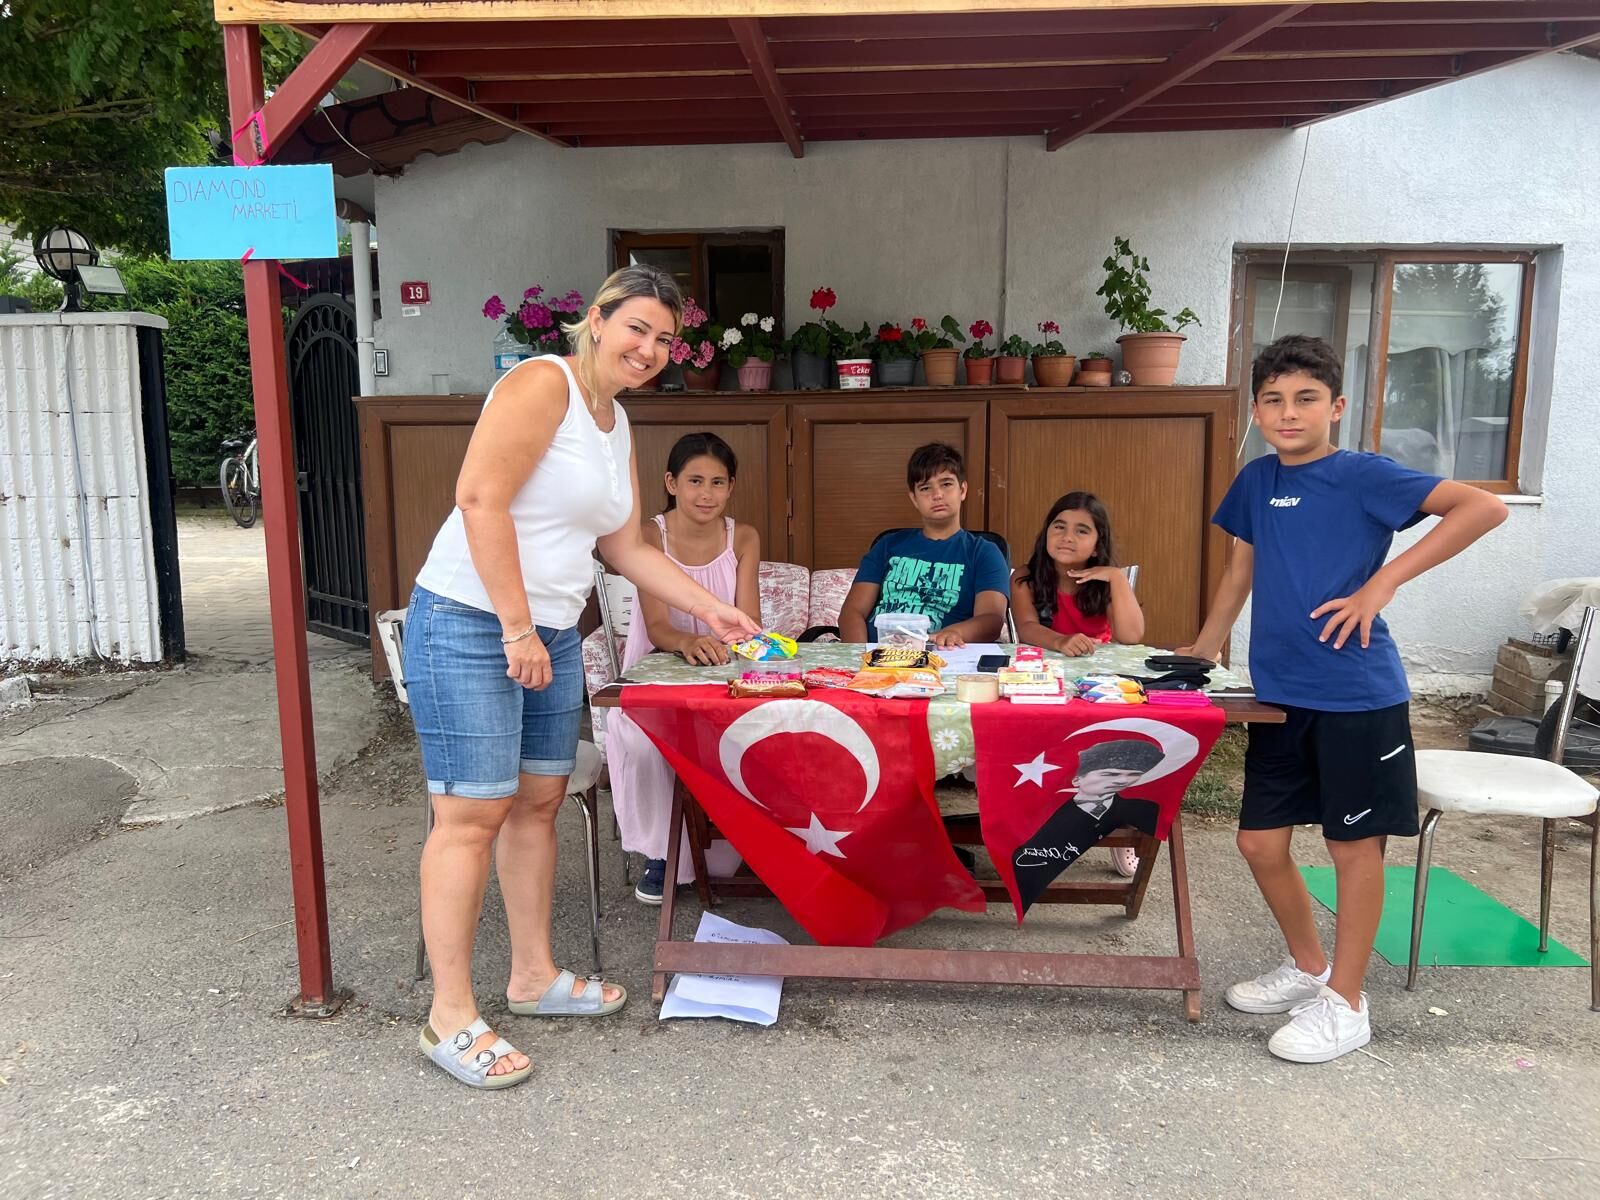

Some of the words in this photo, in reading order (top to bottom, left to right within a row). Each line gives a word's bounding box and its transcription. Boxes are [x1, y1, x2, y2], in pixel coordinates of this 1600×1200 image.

[173, 179, 266, 203] DIAMOND
[409, 286, 423, 299] 19
[932, 562, 965, 592] THE
